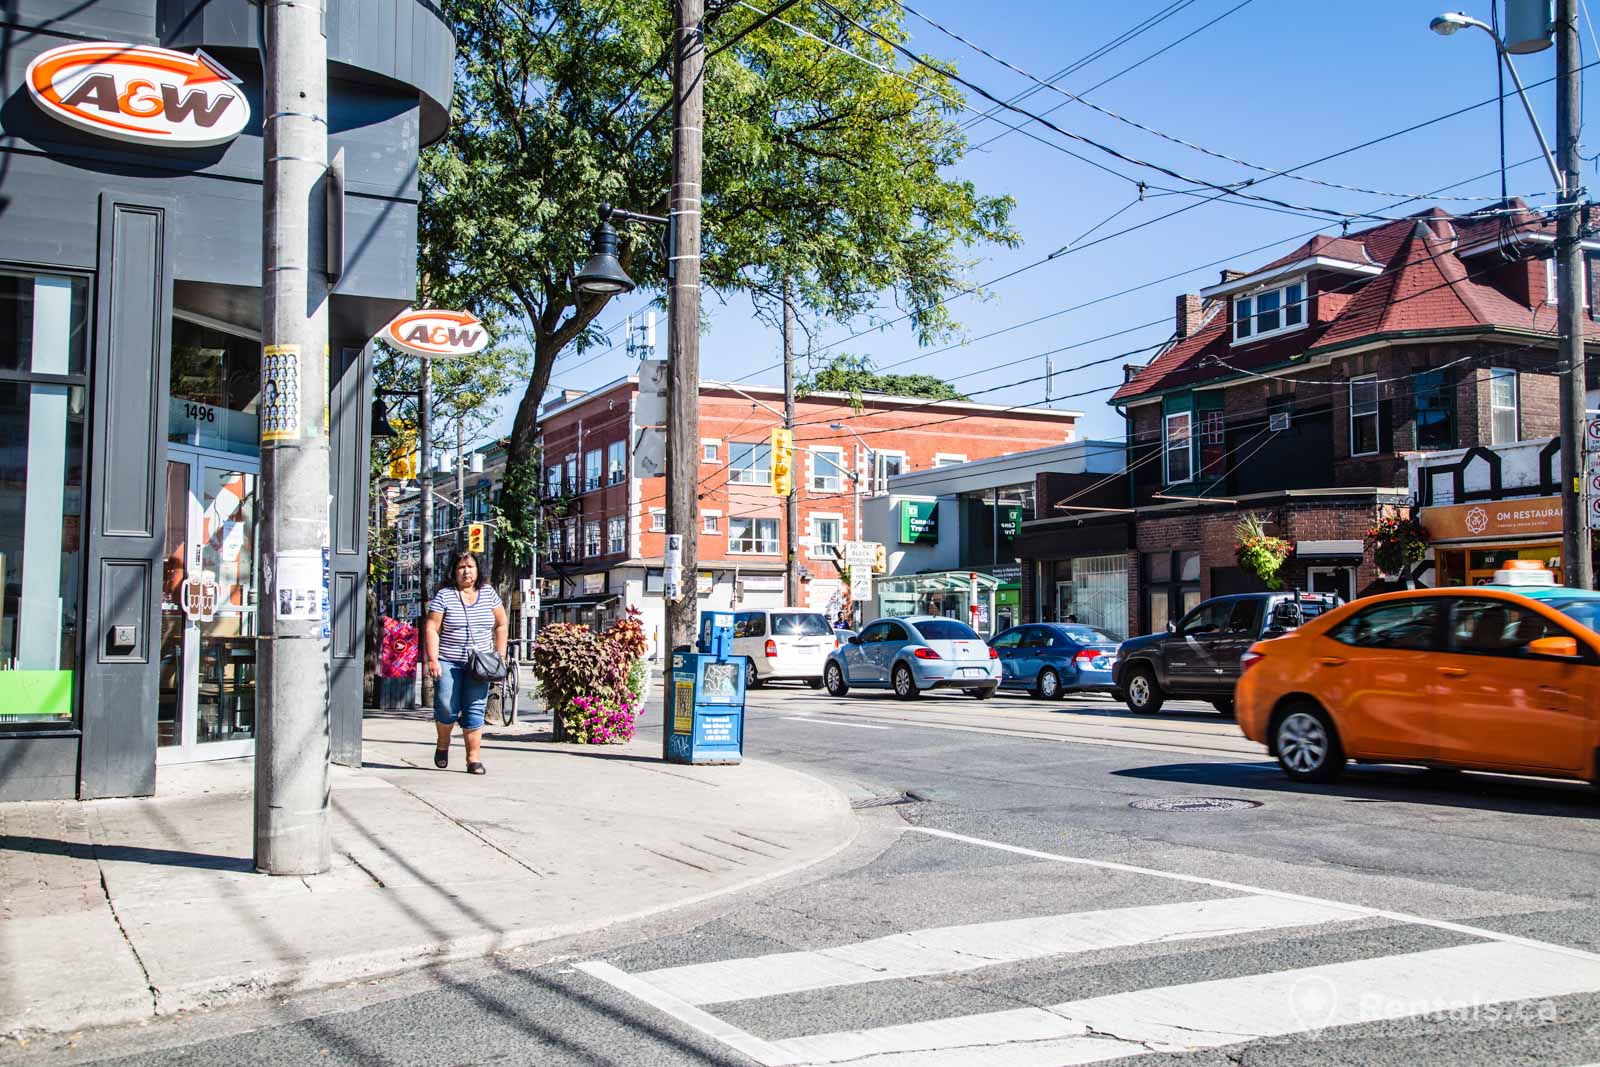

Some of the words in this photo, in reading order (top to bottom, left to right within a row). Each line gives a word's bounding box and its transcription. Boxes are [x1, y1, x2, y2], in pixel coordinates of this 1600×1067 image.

[58, 72, 236, 128] A&W
[405, 324, 482, 348] A&W
[184, 403, 214, 423] 1496
[1496, 512, 1511, 521] OM
